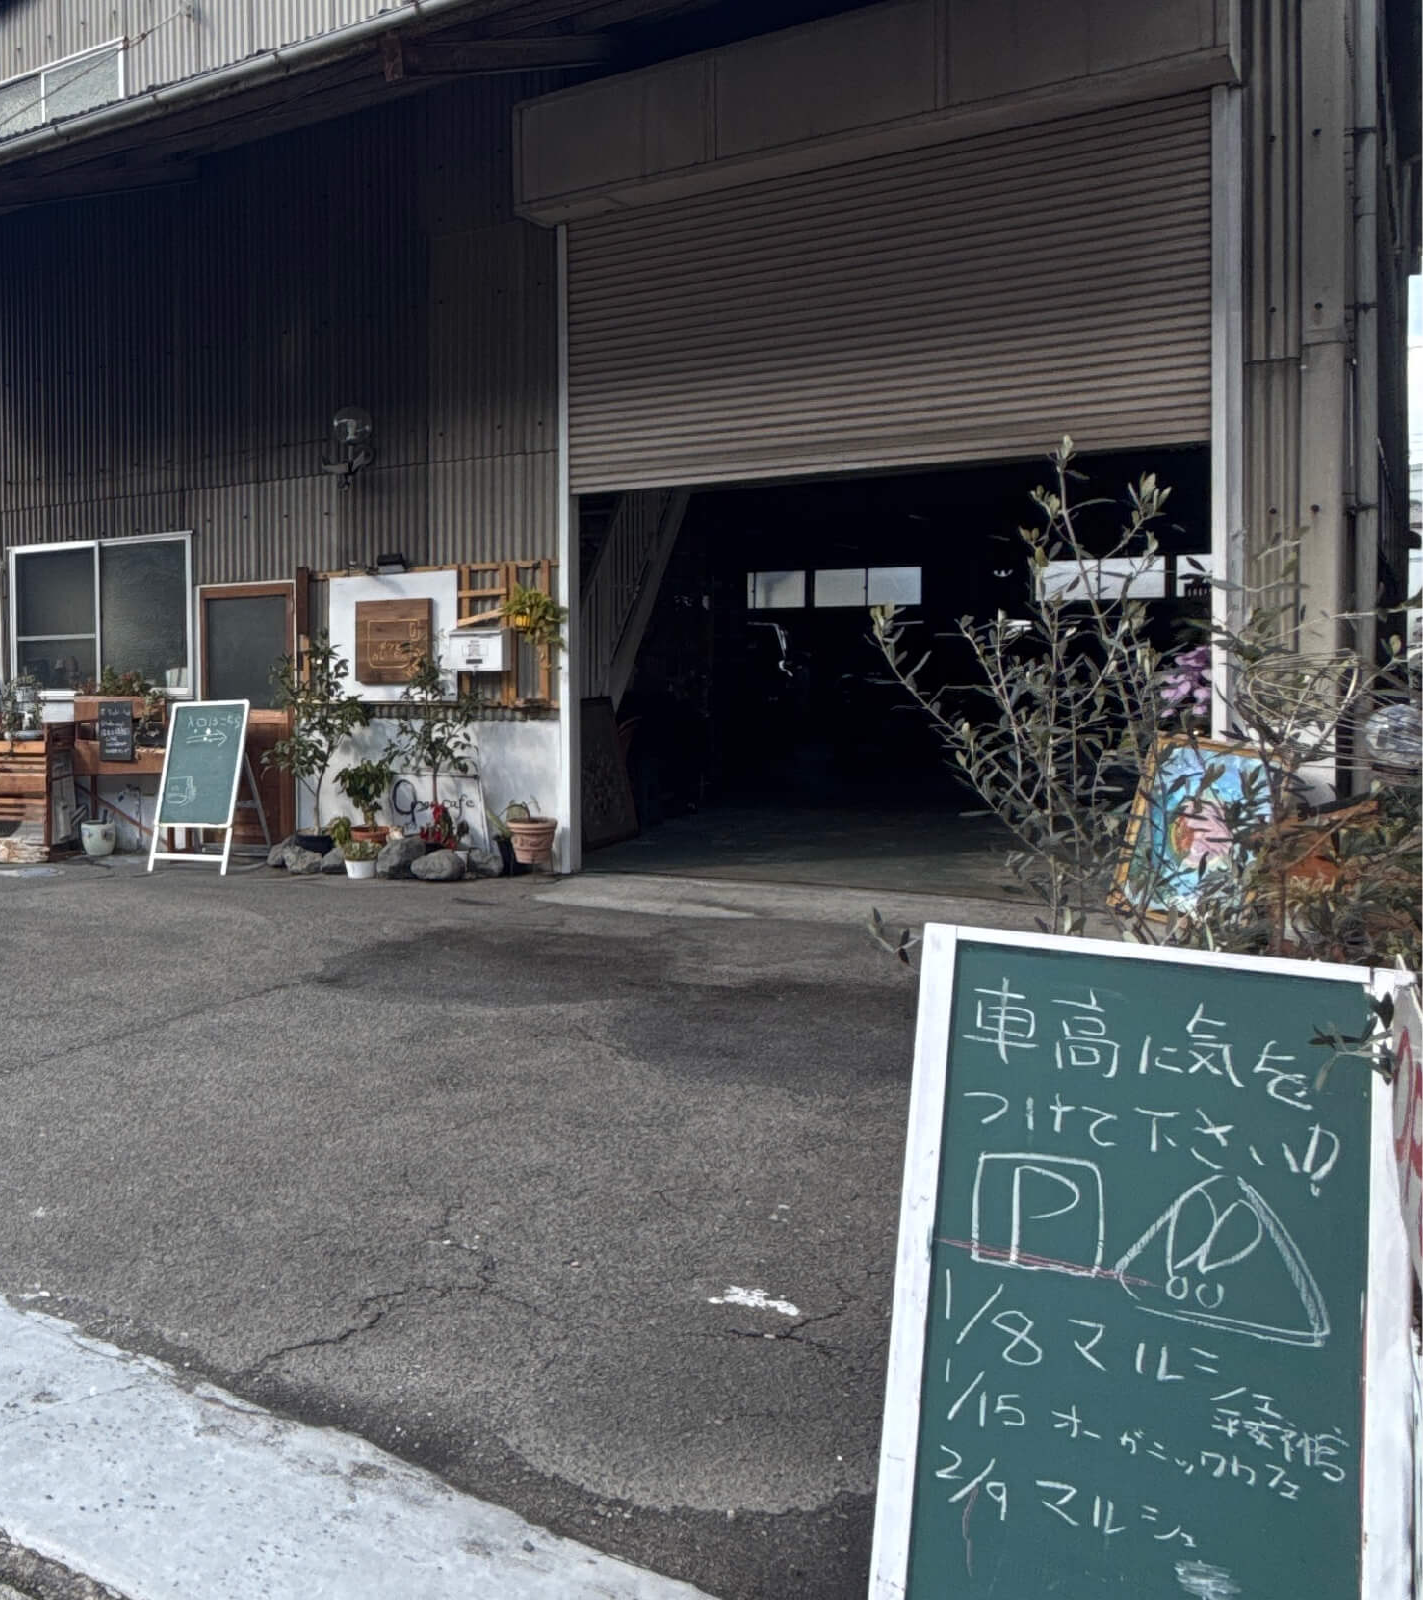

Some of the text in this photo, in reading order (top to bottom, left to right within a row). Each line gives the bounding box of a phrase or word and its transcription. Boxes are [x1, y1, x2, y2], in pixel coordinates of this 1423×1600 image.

[964, 978, 1313, 1111] 車高に気を
[945, 1268, 1043, 1366] 1/8
[945, 1357, 1026, 1428] 1/15
[936, 1444, 1008, 1521] 2/9
